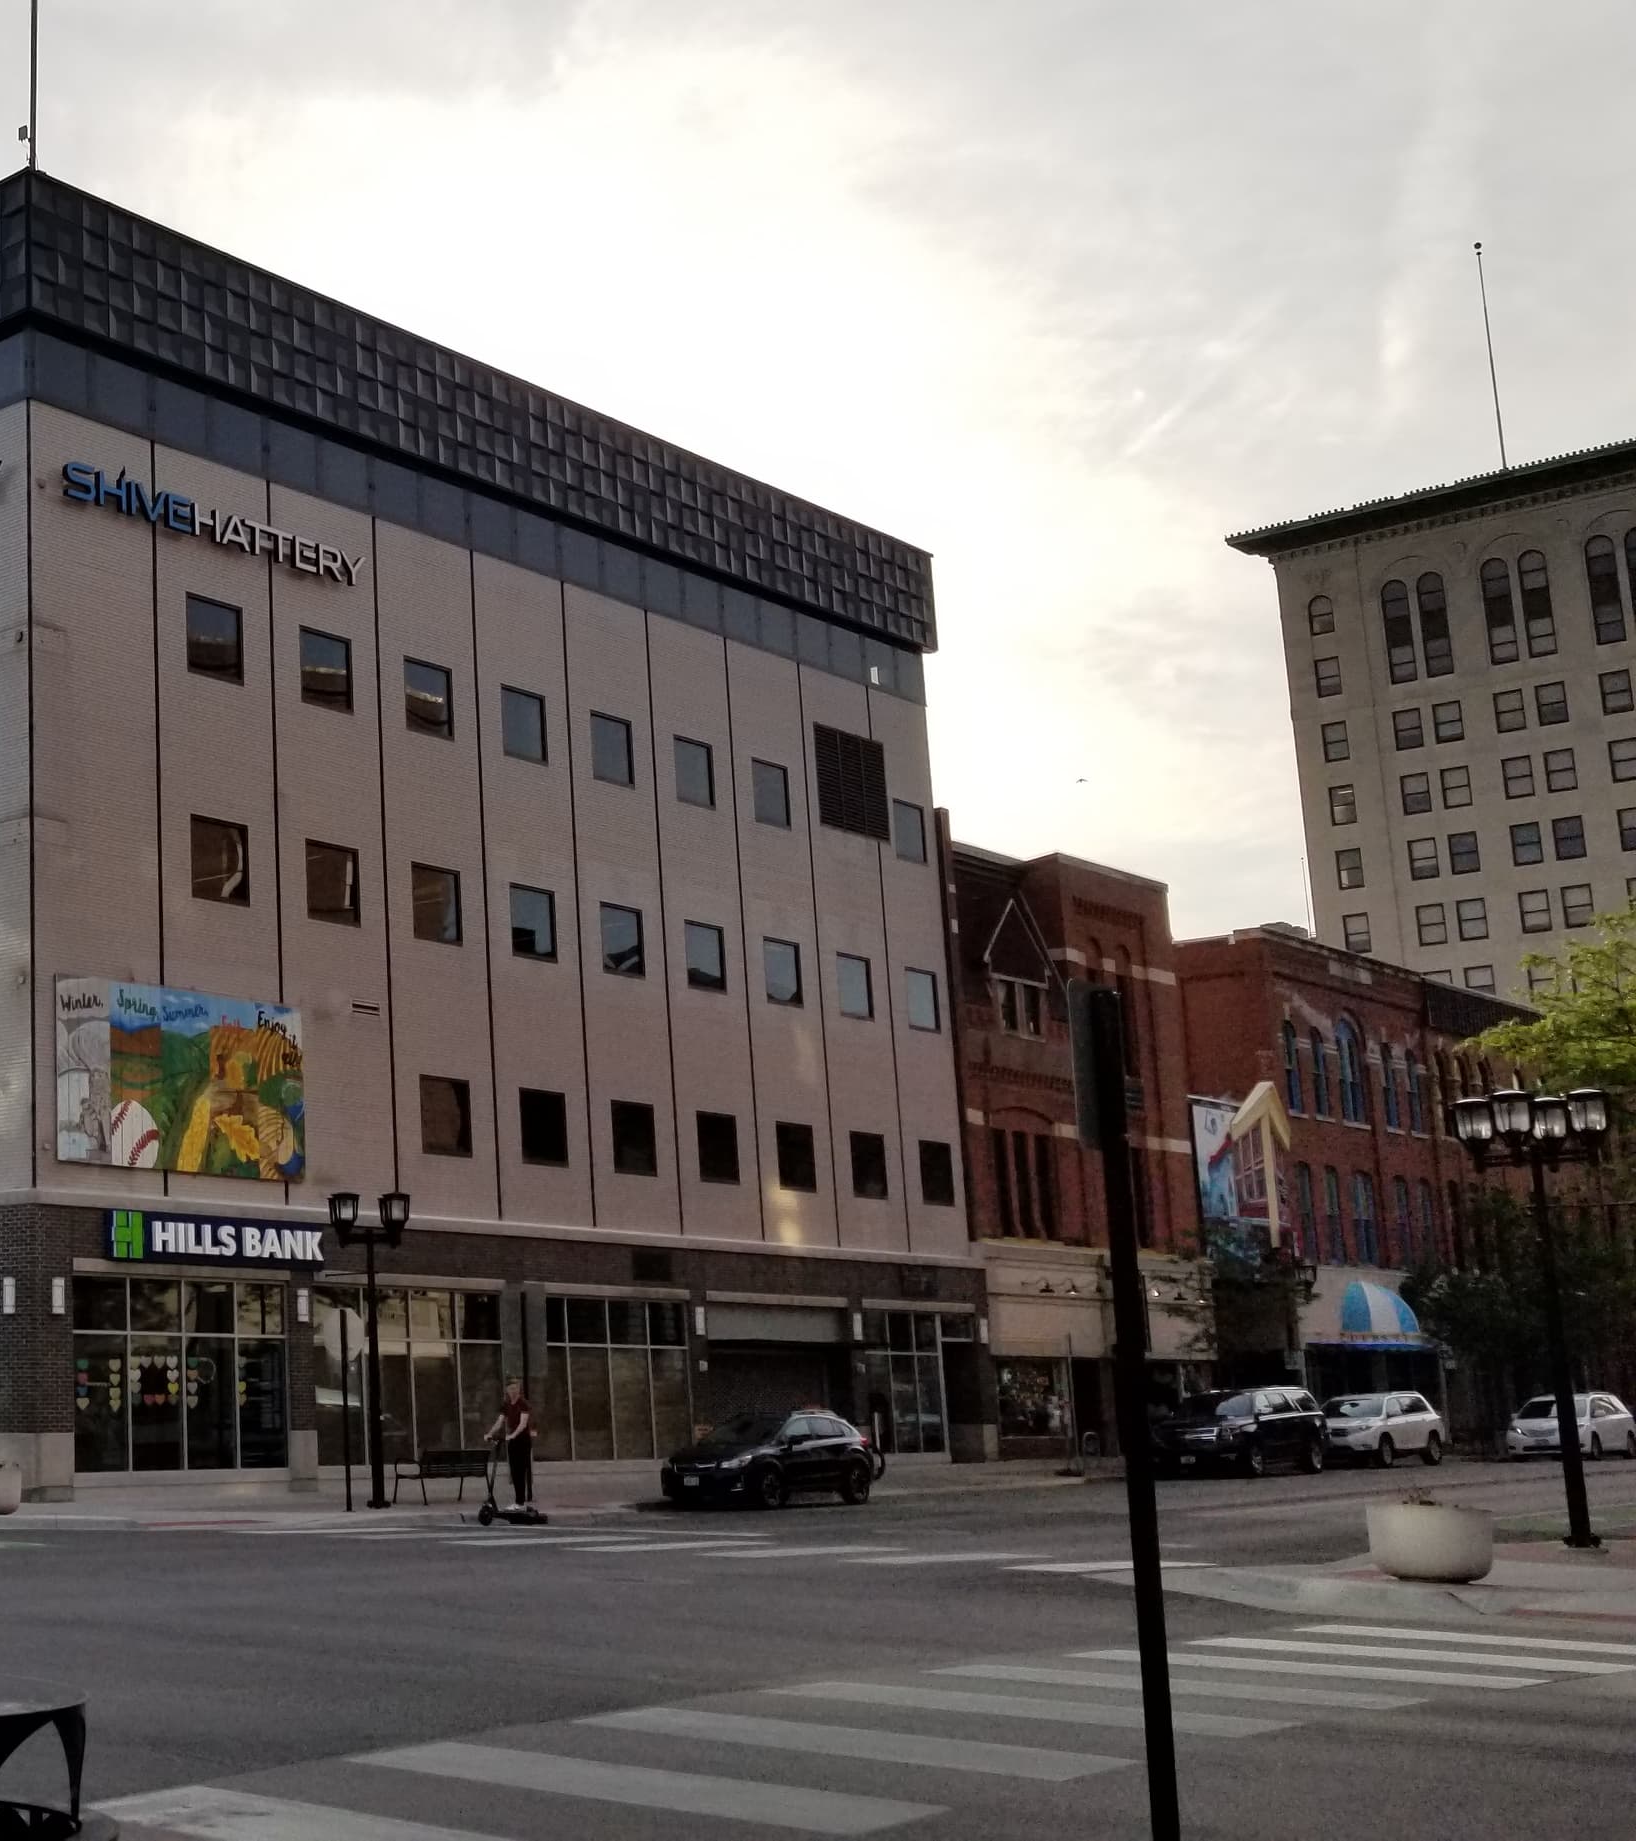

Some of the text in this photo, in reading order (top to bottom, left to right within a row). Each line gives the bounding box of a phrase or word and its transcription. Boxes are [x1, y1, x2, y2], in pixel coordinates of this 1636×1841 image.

[62, 461, 366, 587] SHIVEHATTERY
[258, 1009, 287, 1040] Enjoy
[151, 1221, 236, 1257] HILLS
[242, 1226, 325, 1262] BANK
